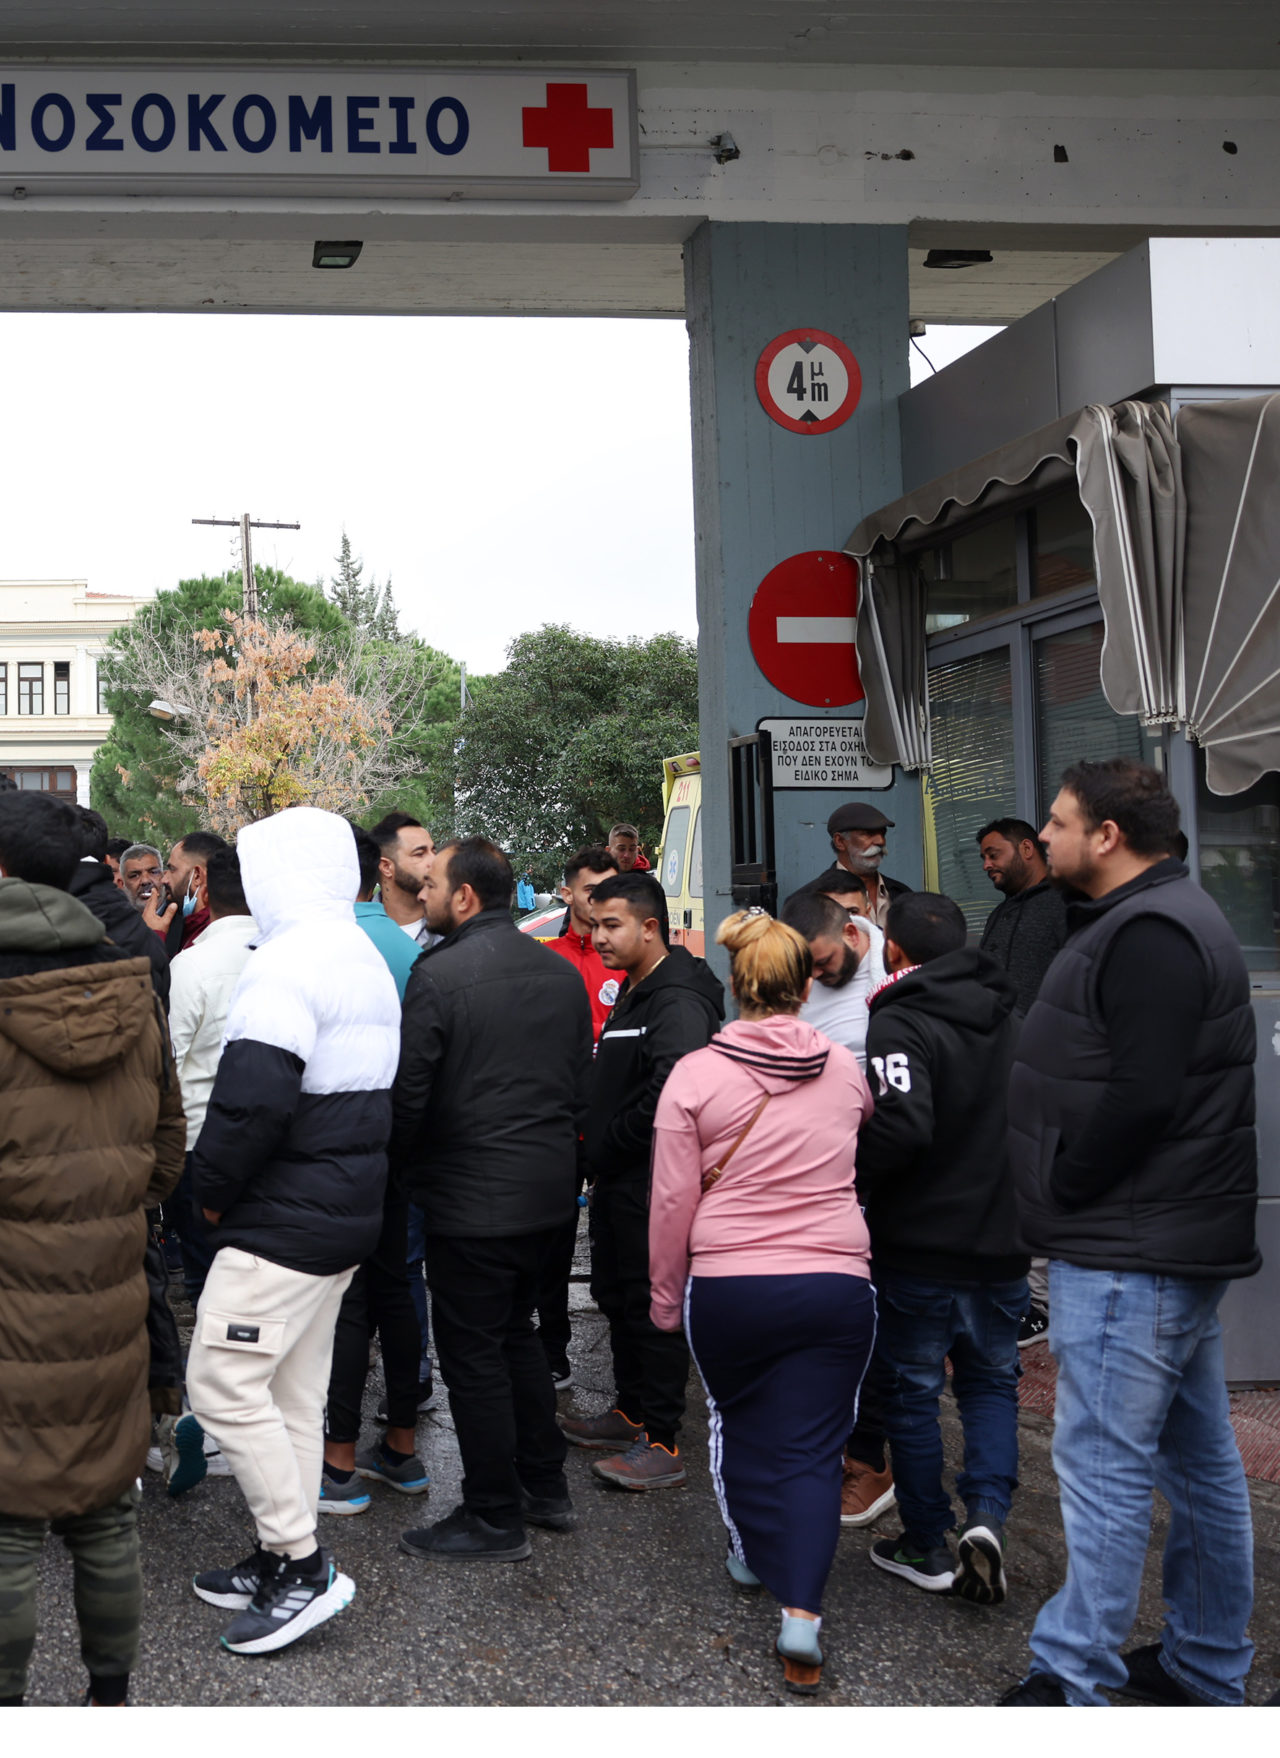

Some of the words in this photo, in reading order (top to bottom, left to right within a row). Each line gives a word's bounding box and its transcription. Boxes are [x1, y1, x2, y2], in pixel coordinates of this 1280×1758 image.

[787, 361, 807, 401] 4
[811, 382, 829, 402] m
[773, 741, 815, 752] ΕΙΣΟΔΟΣ
[819, 741, 837, 752] ΣΤΑ
[778, 756, 798, 766] ΠΟΥ
[801, 756, 821, 766] ΔΕΝ
[825, 756, 857, 767] ΕΧΟΥΝ
[794, 770, 828, 781] ΕΙΔΙΚΟ
[831, 771, 859, 781] ΣΗΜΑ
[677, 781, 690, 802] 211
